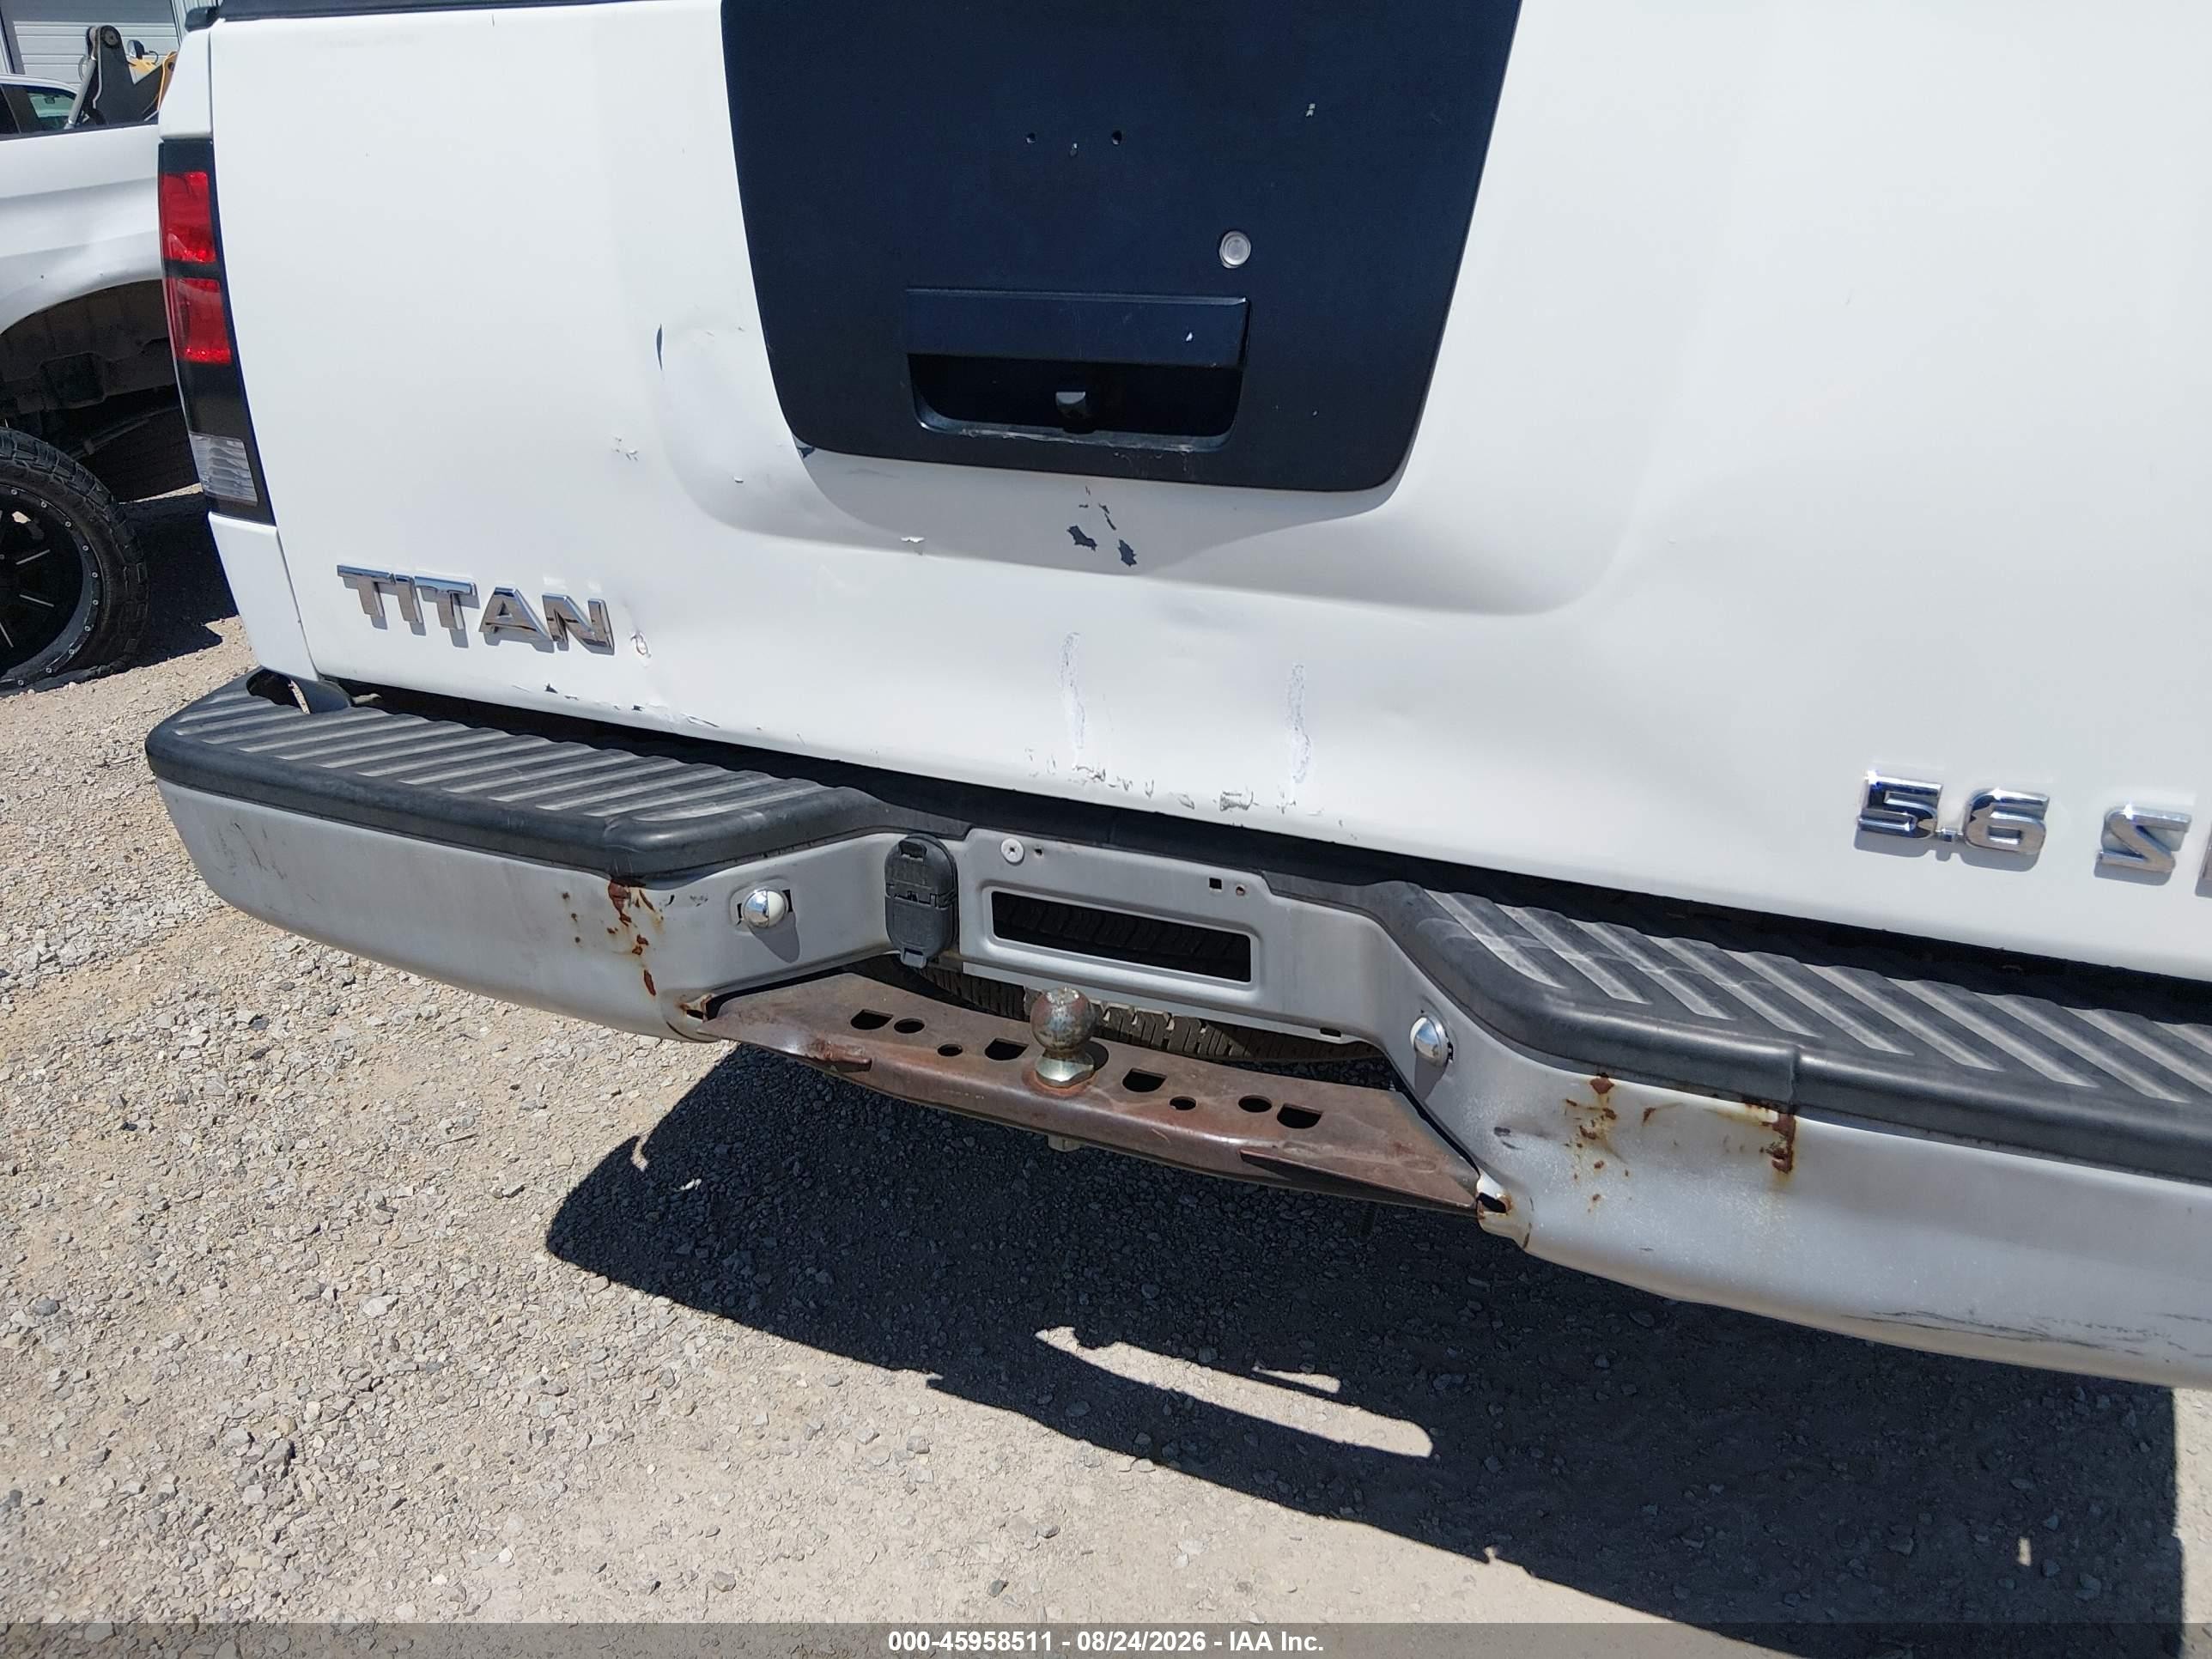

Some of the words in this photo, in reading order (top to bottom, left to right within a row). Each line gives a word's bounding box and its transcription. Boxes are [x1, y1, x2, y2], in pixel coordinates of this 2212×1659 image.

[337, 564, 616, 651] TITAN
[1856, 772, 2050, 854] 5.6
[2097, 805, 2212, 881] S
